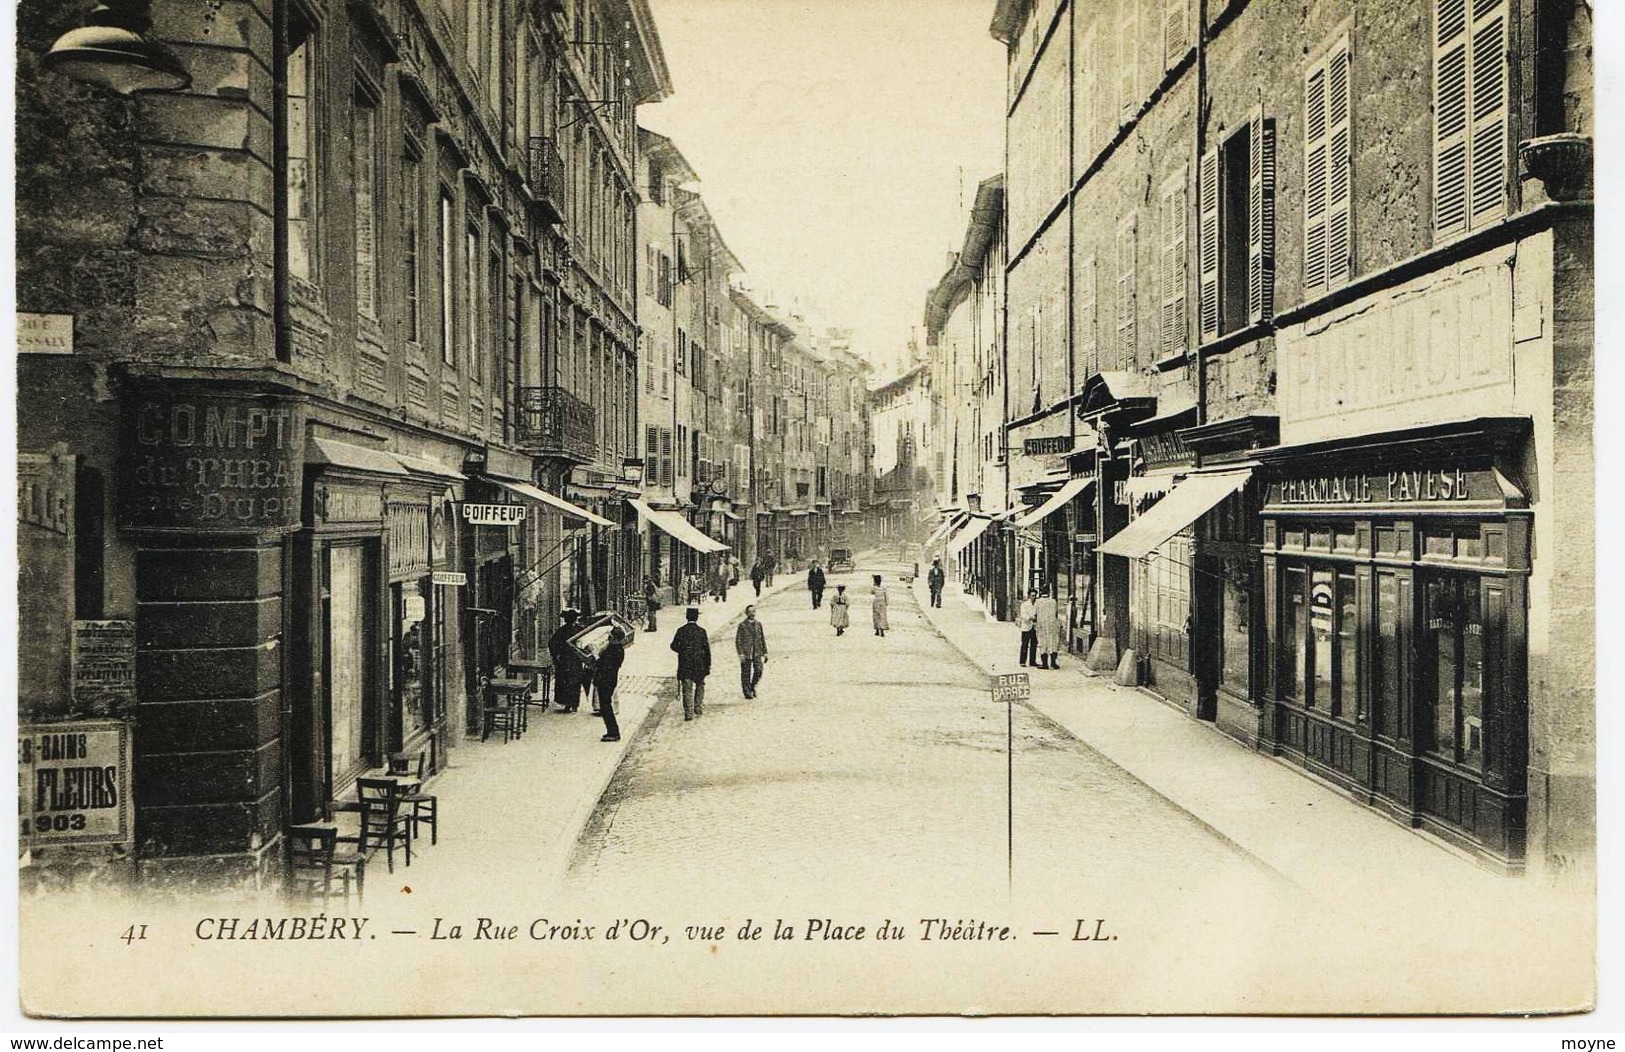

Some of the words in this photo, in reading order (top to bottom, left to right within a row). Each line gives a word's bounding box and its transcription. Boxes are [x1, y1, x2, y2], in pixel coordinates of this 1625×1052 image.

[1024, 438, 1071, 454] COIFFEUR
[1281, 473, 1372, 502] PHARMACIE
[1387, 468, 1469, 500] PAVESE
[464, 504, 524, 522] COIFFEUR
[999, 675, 1024, 686] RUE
[36, 765, 118, 811] FLEURS
[21, 814, 87, 836] 1903
